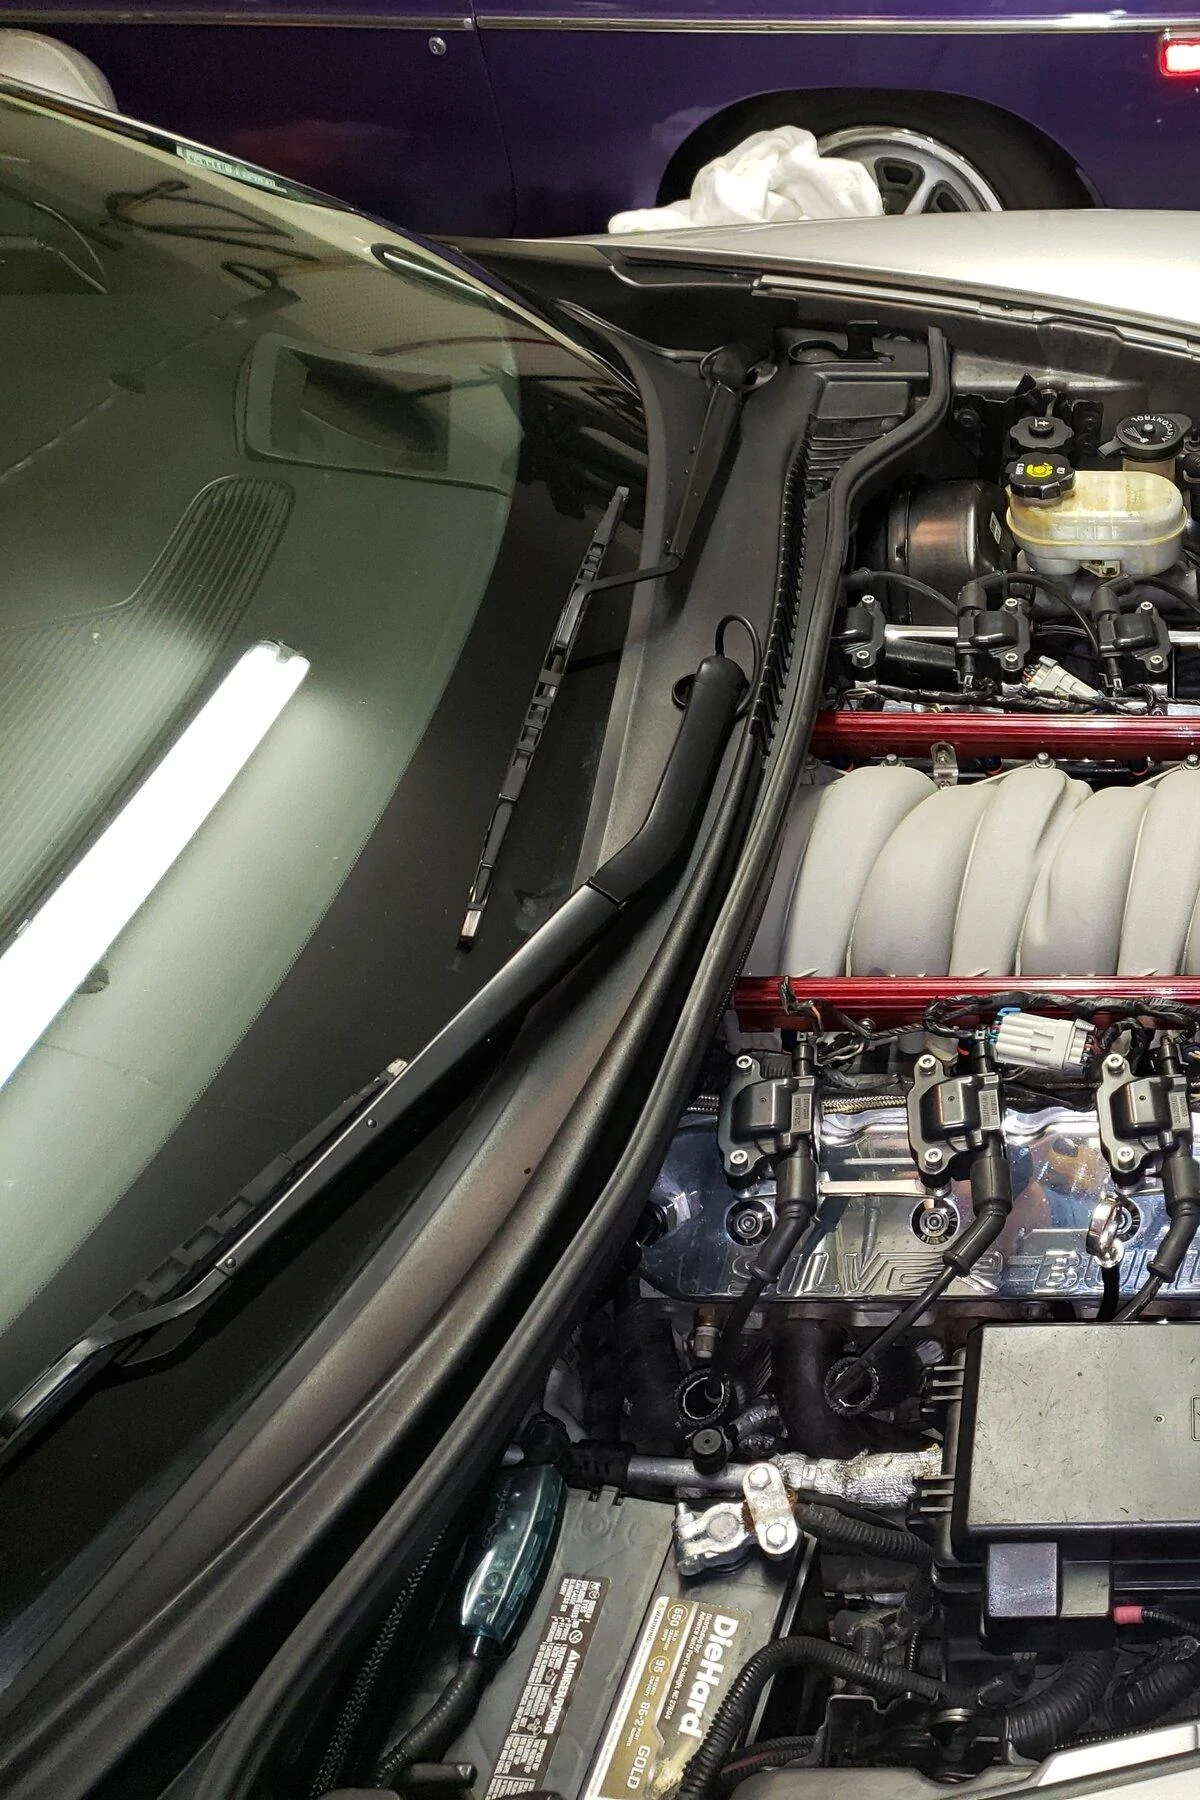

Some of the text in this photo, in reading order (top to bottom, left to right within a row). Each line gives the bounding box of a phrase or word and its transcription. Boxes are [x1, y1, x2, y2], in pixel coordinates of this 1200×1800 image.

[669, 1607, 684, 1626] 650
[653, 1659, 664, 1672] 95
[679, 1615, 739, 1738] DieHard
[627, 1744, 650, 1788] GOLD
